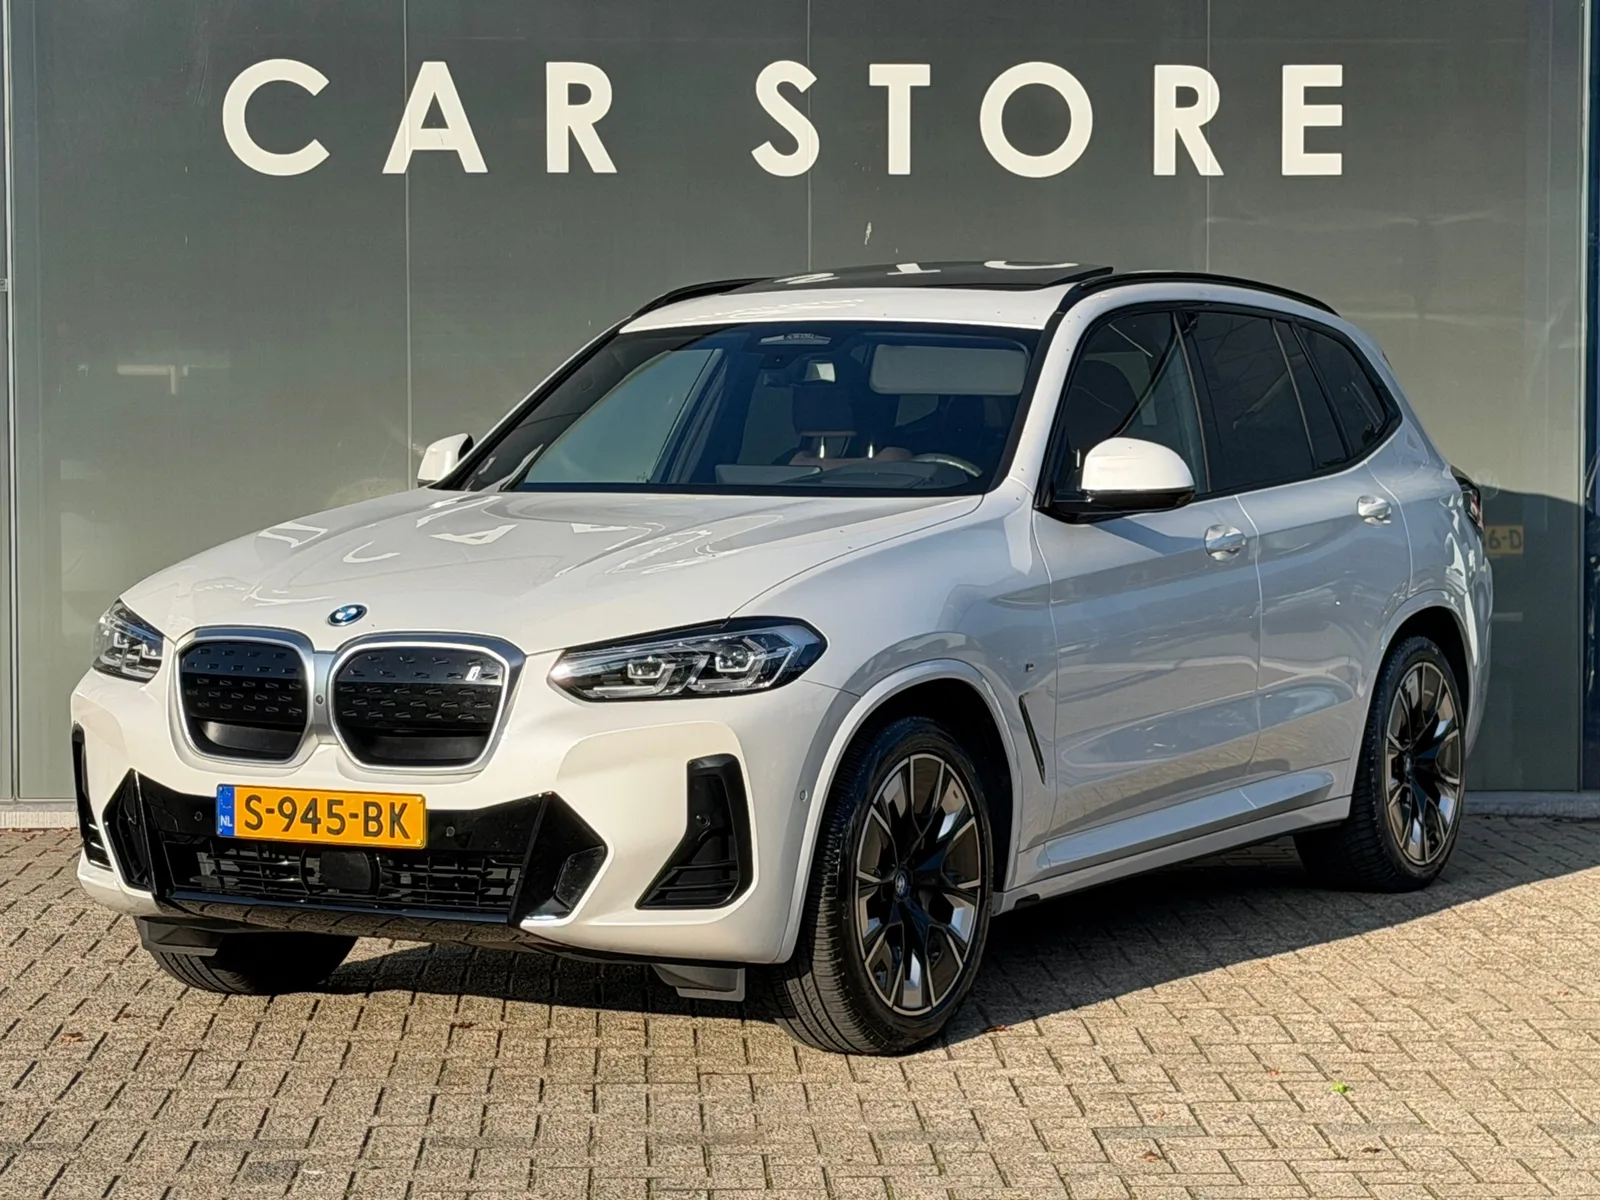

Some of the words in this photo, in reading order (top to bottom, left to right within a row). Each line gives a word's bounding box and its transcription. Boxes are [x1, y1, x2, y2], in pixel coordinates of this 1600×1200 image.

[222, 58, 618, 176] CAR
[751, 60, 1343, 178] STORE
[1484, 529, 1522, 550] 6-D
[220, 815, 233, 827] NL
[244, 794, 410, 839] S-945-BK
